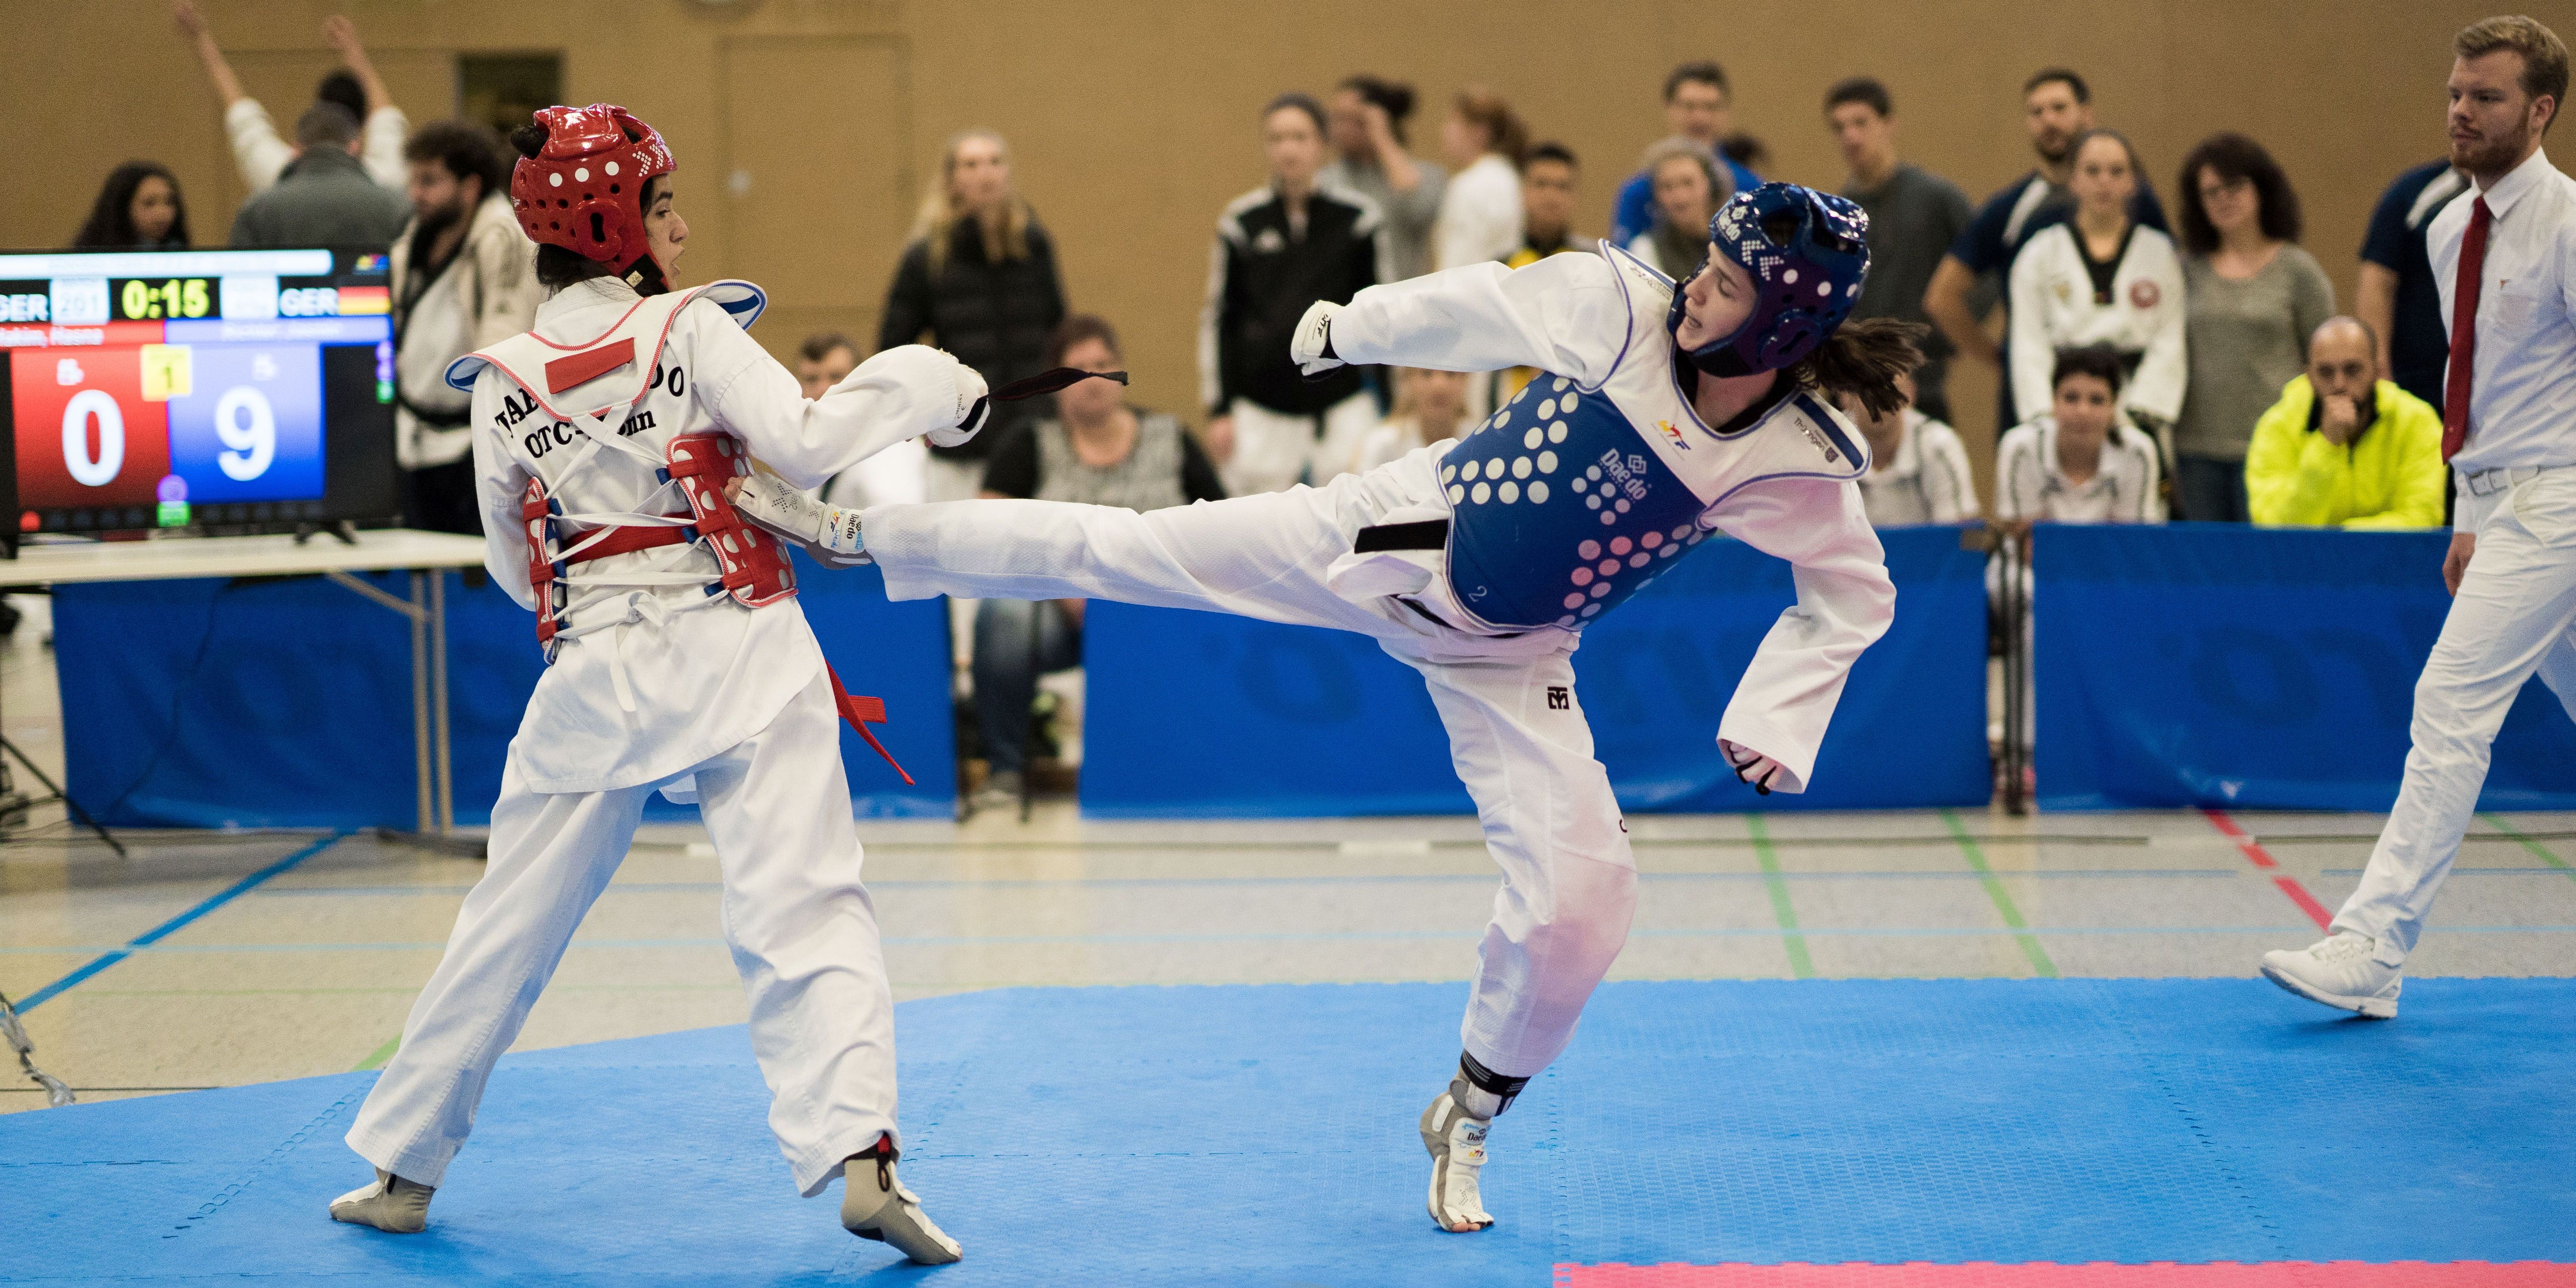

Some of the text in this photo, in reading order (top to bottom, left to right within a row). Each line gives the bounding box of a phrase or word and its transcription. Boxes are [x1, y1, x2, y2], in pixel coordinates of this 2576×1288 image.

[122, 279, 210, 319] 0:15
[279, 287, 338, 317] GER
[495, 362, 684, 438] TAEDO
[61, 389, 125, 486] 0
[215, 386, 276, 481] 9
[524, 410, 656, 458] OTC-nn
[1600, 448, 1647, 500] Daedo
[846, 513, 859, 539] Daedo
[1468, 585, 1488, 602] 2
